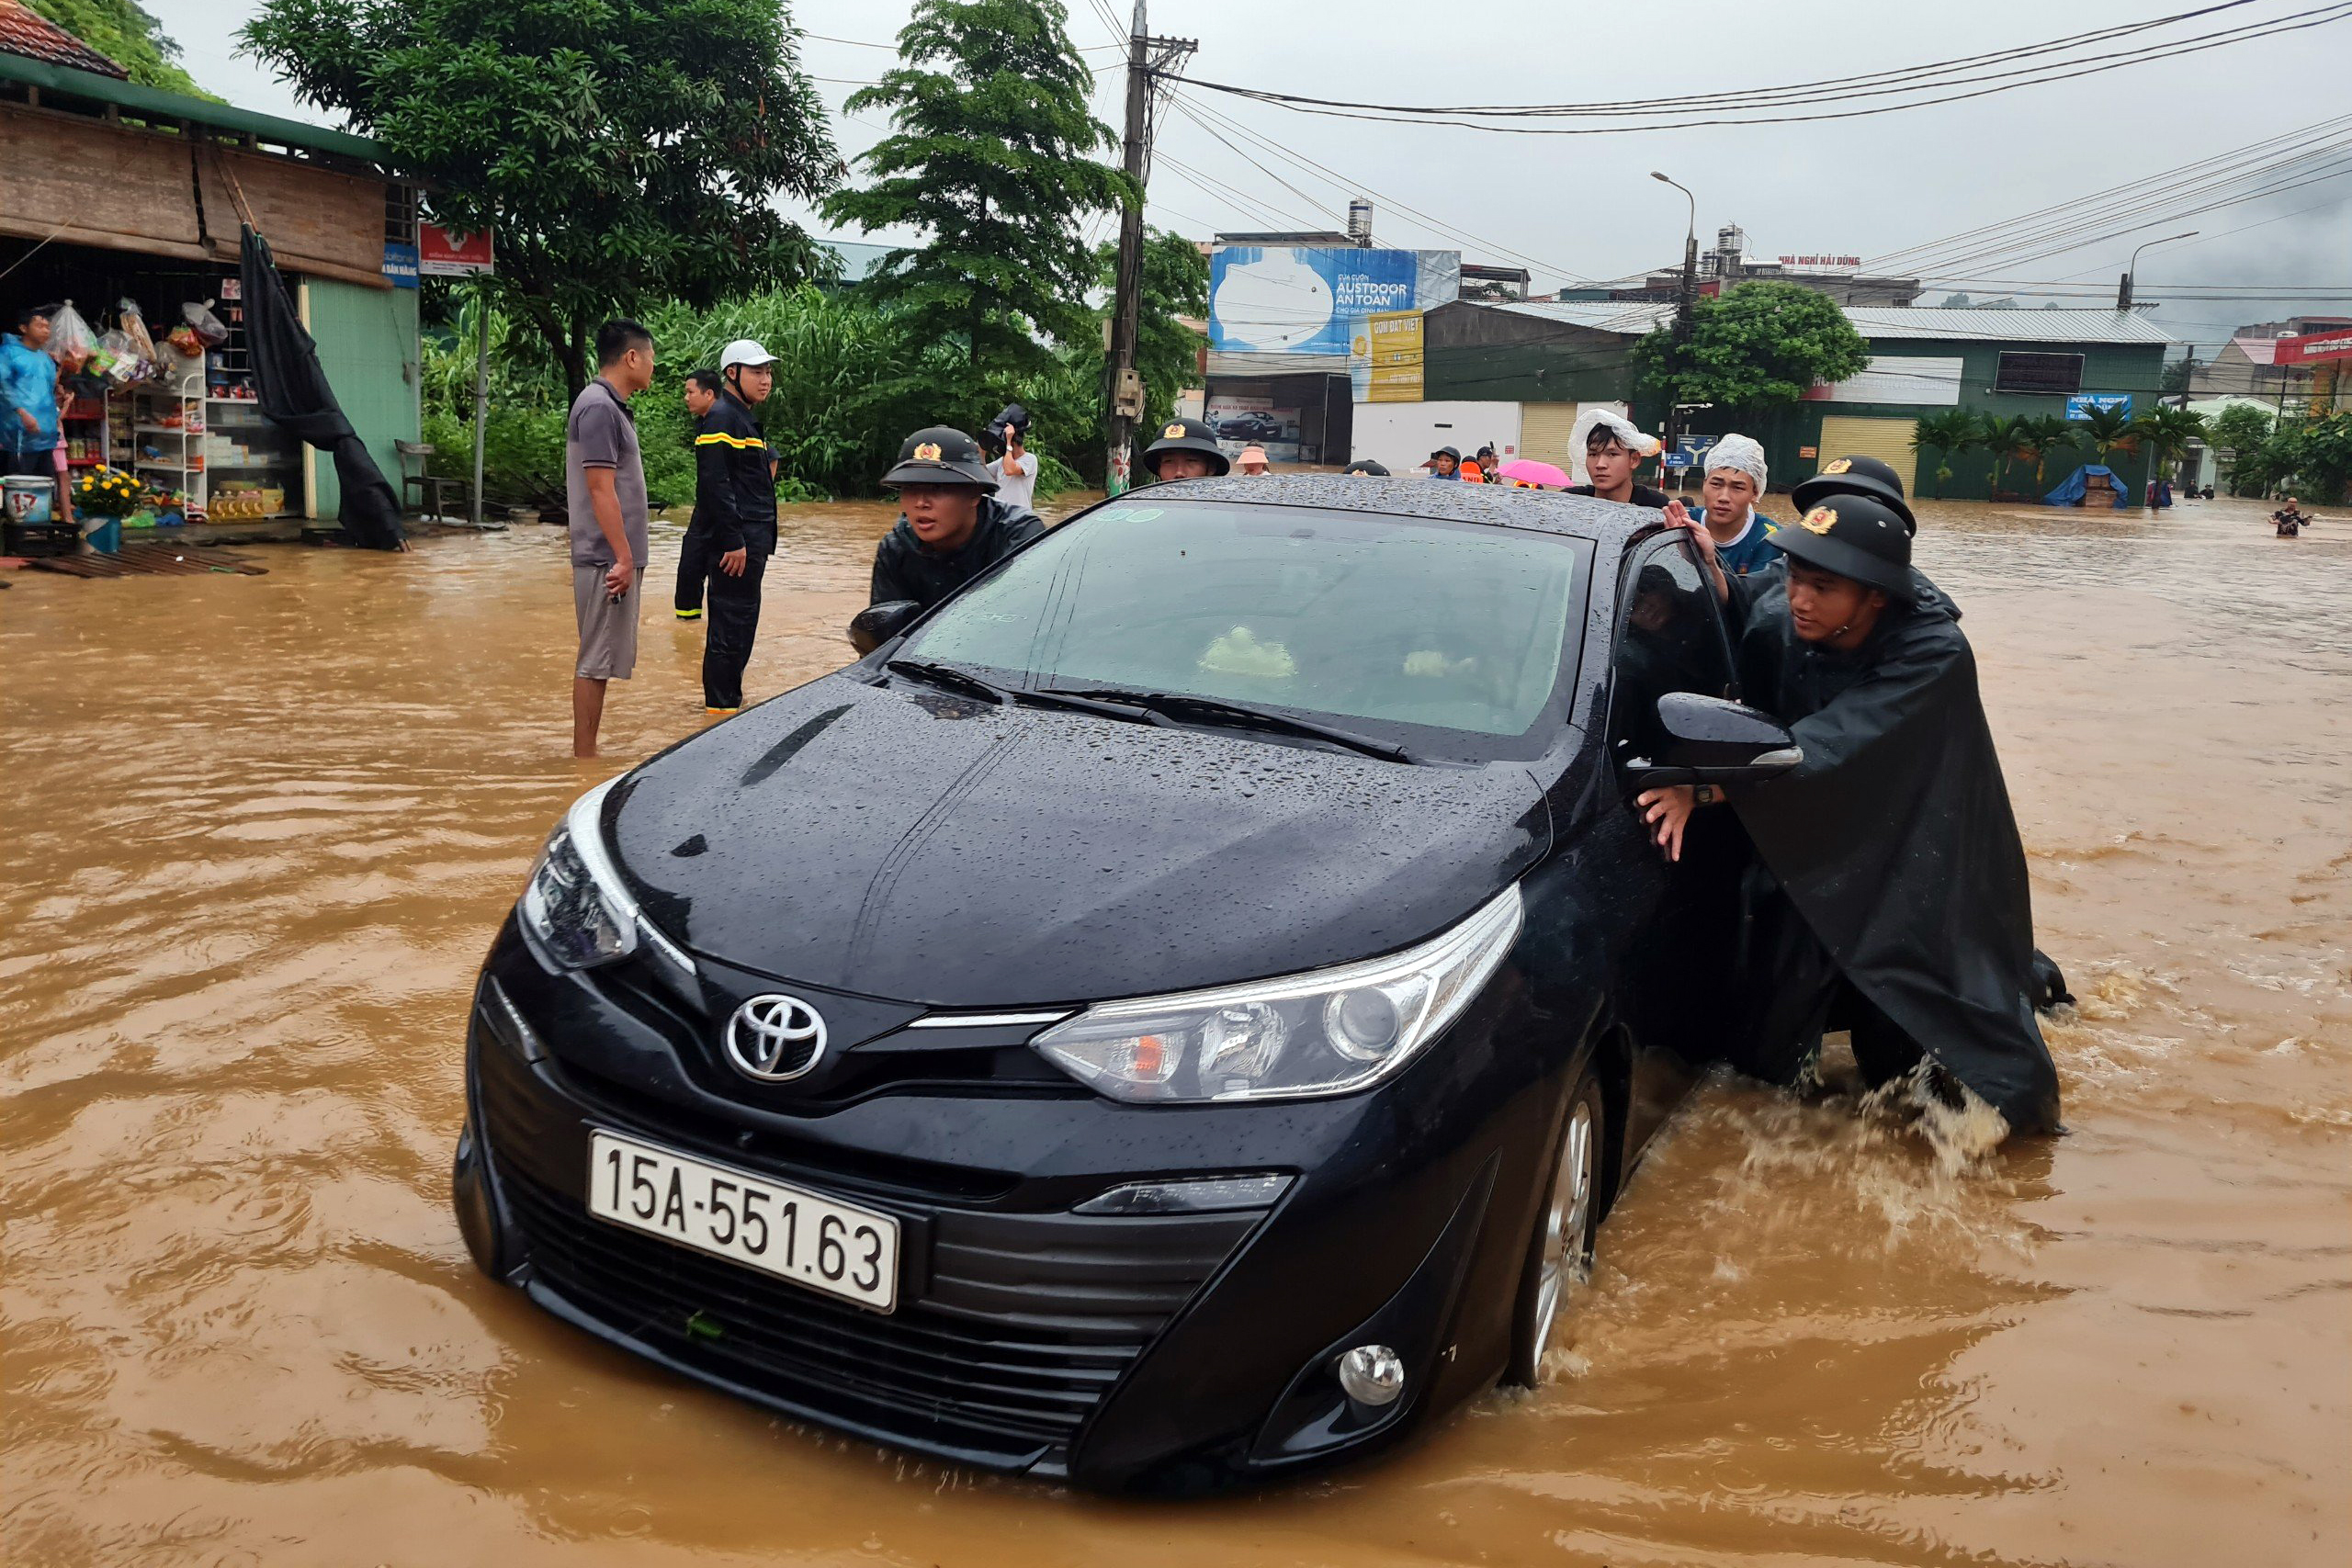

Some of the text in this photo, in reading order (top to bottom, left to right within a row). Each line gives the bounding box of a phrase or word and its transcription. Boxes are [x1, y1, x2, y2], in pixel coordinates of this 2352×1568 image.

[1798, 253, 1818, 265] NGHỈ
[1820, 253, 1835, 265] HẢI
[1337, 282, 1408, 295] AUSTDOOR
[1336, 294, 1354, 305] AN
[607, 1148, 882, 1292] 15A-551.63
